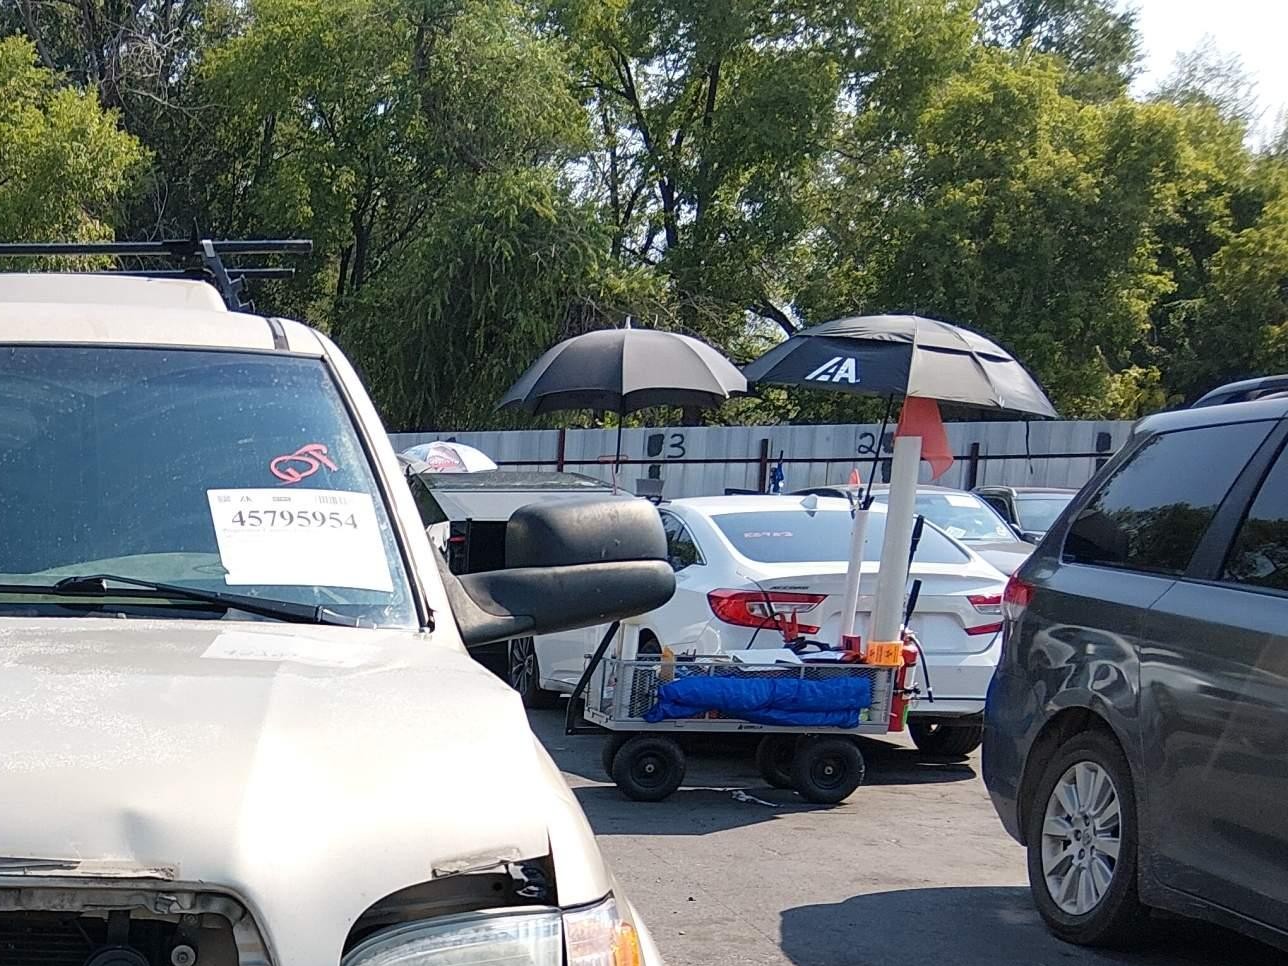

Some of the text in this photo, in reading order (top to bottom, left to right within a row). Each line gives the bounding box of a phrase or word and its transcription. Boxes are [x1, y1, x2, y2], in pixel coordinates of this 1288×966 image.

[666, 433, 686, 459] 3
[857, 432, 877, 455] 2
[231, 509, 359, 530] 45795954
